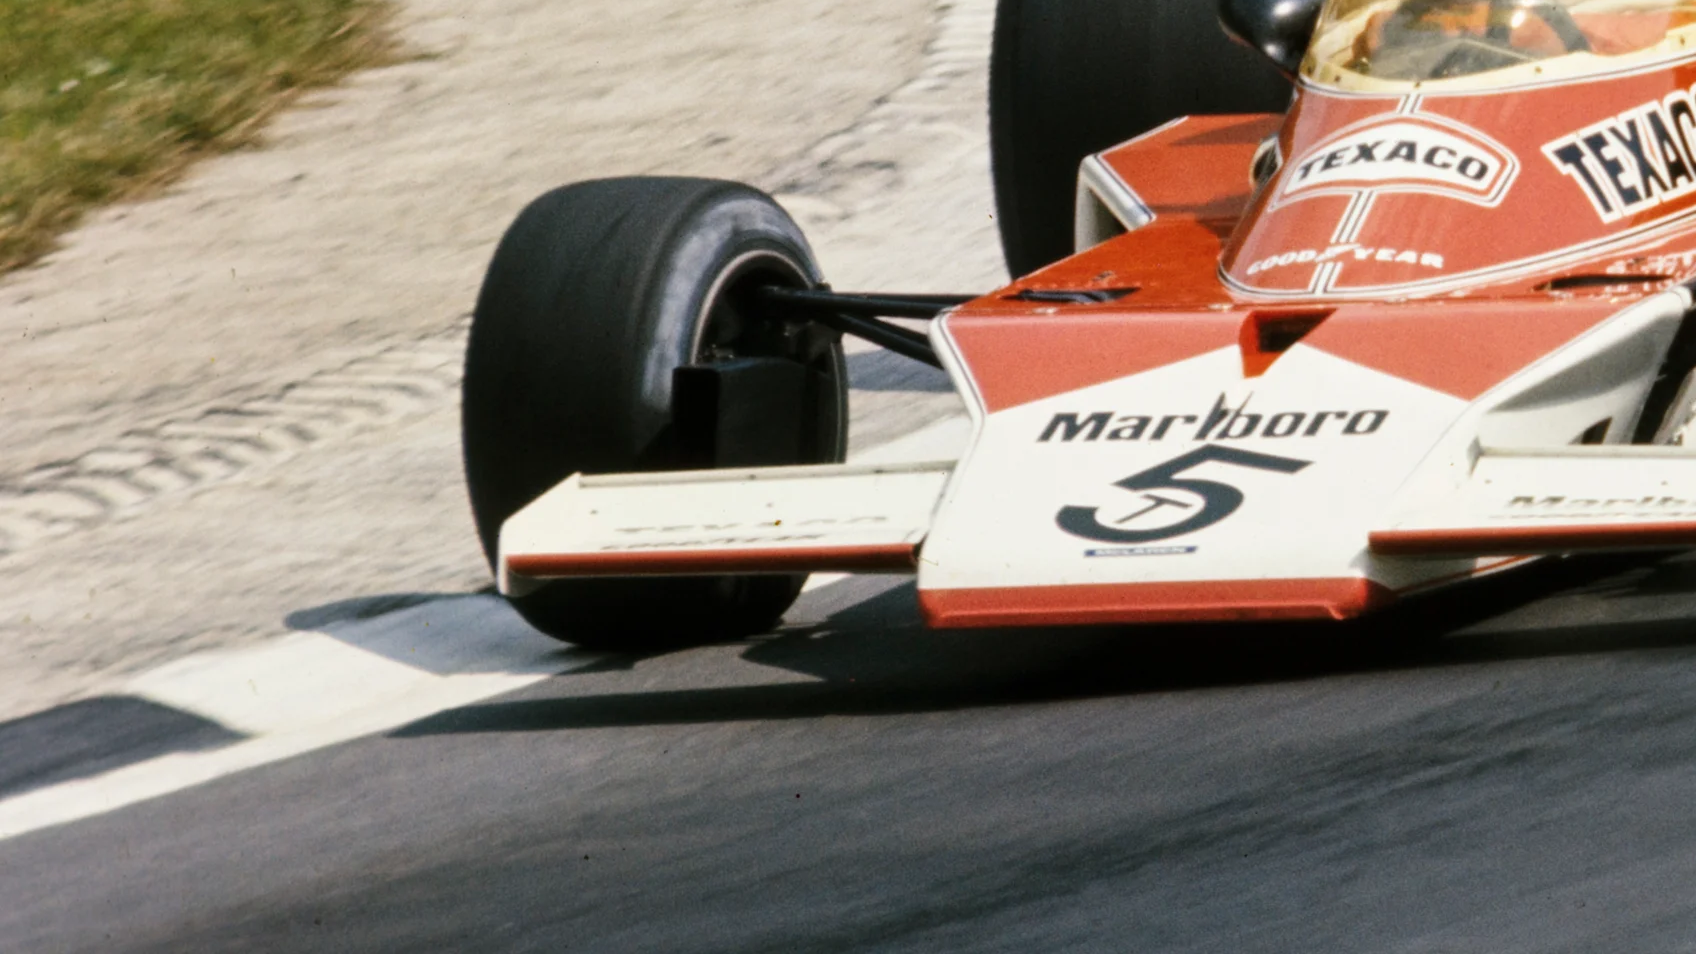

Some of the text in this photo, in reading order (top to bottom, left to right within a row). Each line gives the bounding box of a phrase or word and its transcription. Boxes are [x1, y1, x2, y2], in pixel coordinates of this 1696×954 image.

[1297, 138, 1490, 182] TEXACO
[1037, 391, 1390, 442] Marlboro
[1055, 443, 1315, 544] 5
